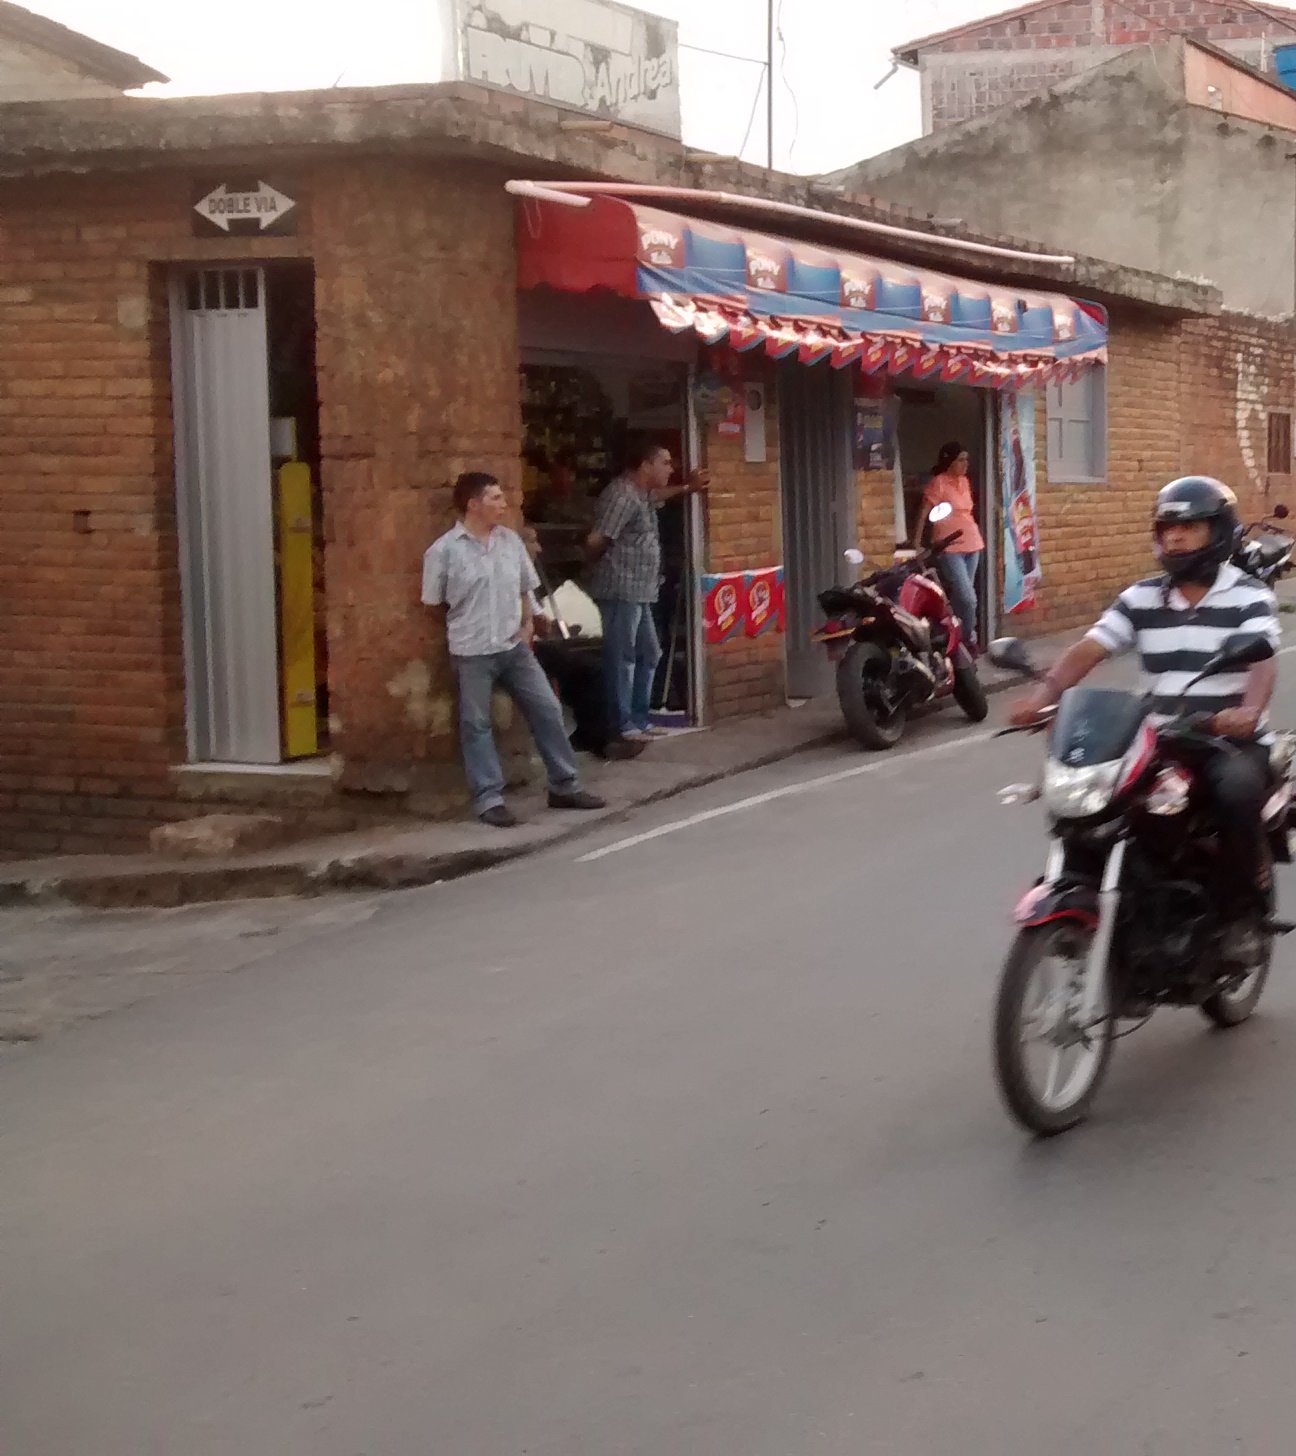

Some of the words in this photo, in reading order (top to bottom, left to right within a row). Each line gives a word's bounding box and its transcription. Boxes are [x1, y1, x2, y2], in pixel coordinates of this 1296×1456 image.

[208, 197, 251, 214] DOBLE
[253, 196, 278, 213] VIA
[641, 229, 678, 251] PONY
[749, 256, 781, 276] PONY
